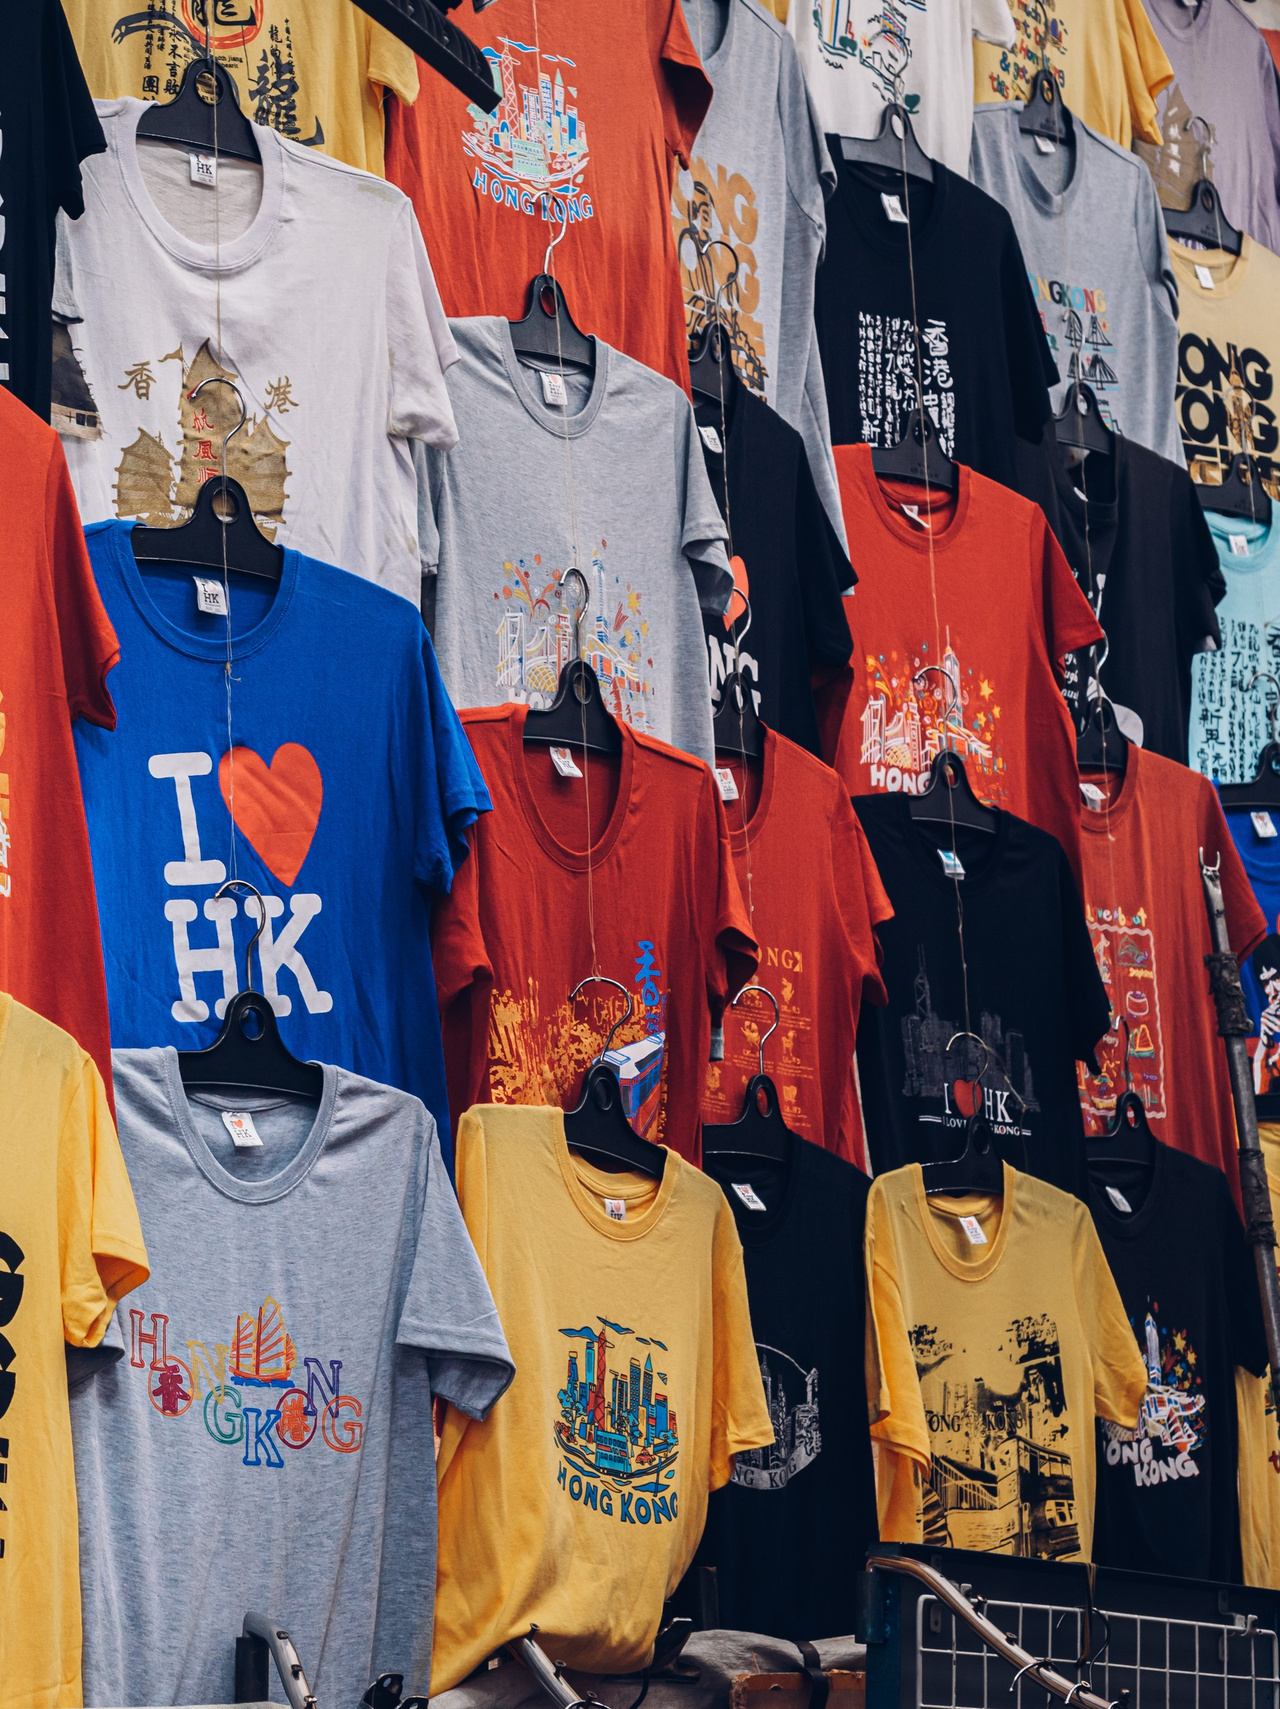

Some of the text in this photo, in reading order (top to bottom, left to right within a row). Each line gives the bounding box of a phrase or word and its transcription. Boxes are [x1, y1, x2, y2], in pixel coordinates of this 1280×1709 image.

[197, 162, 213, 175] HK
[473, 166, 535, 216] HONG
[541, 193, 594, 223] KONG
[118, 361, 156, 400] 香
[263, 375, 299, 414] 港
[203, 592, 220, 604] HK
[148, 751, 226, 886] I
[164, 893, 333, 1022] HK
[943, 1083, 1013, 1123] I HK
[234, 1128, 252, 1139] HK
[994, 1124, 1021, 1136] KONG
[986, 1411, 1024, 1432] KONG
[1103, 1438, 1153, 1466] ONG
[1134, 1452, 1200, 1487] KONG
[557, 1461, 613, 1516] HONG
